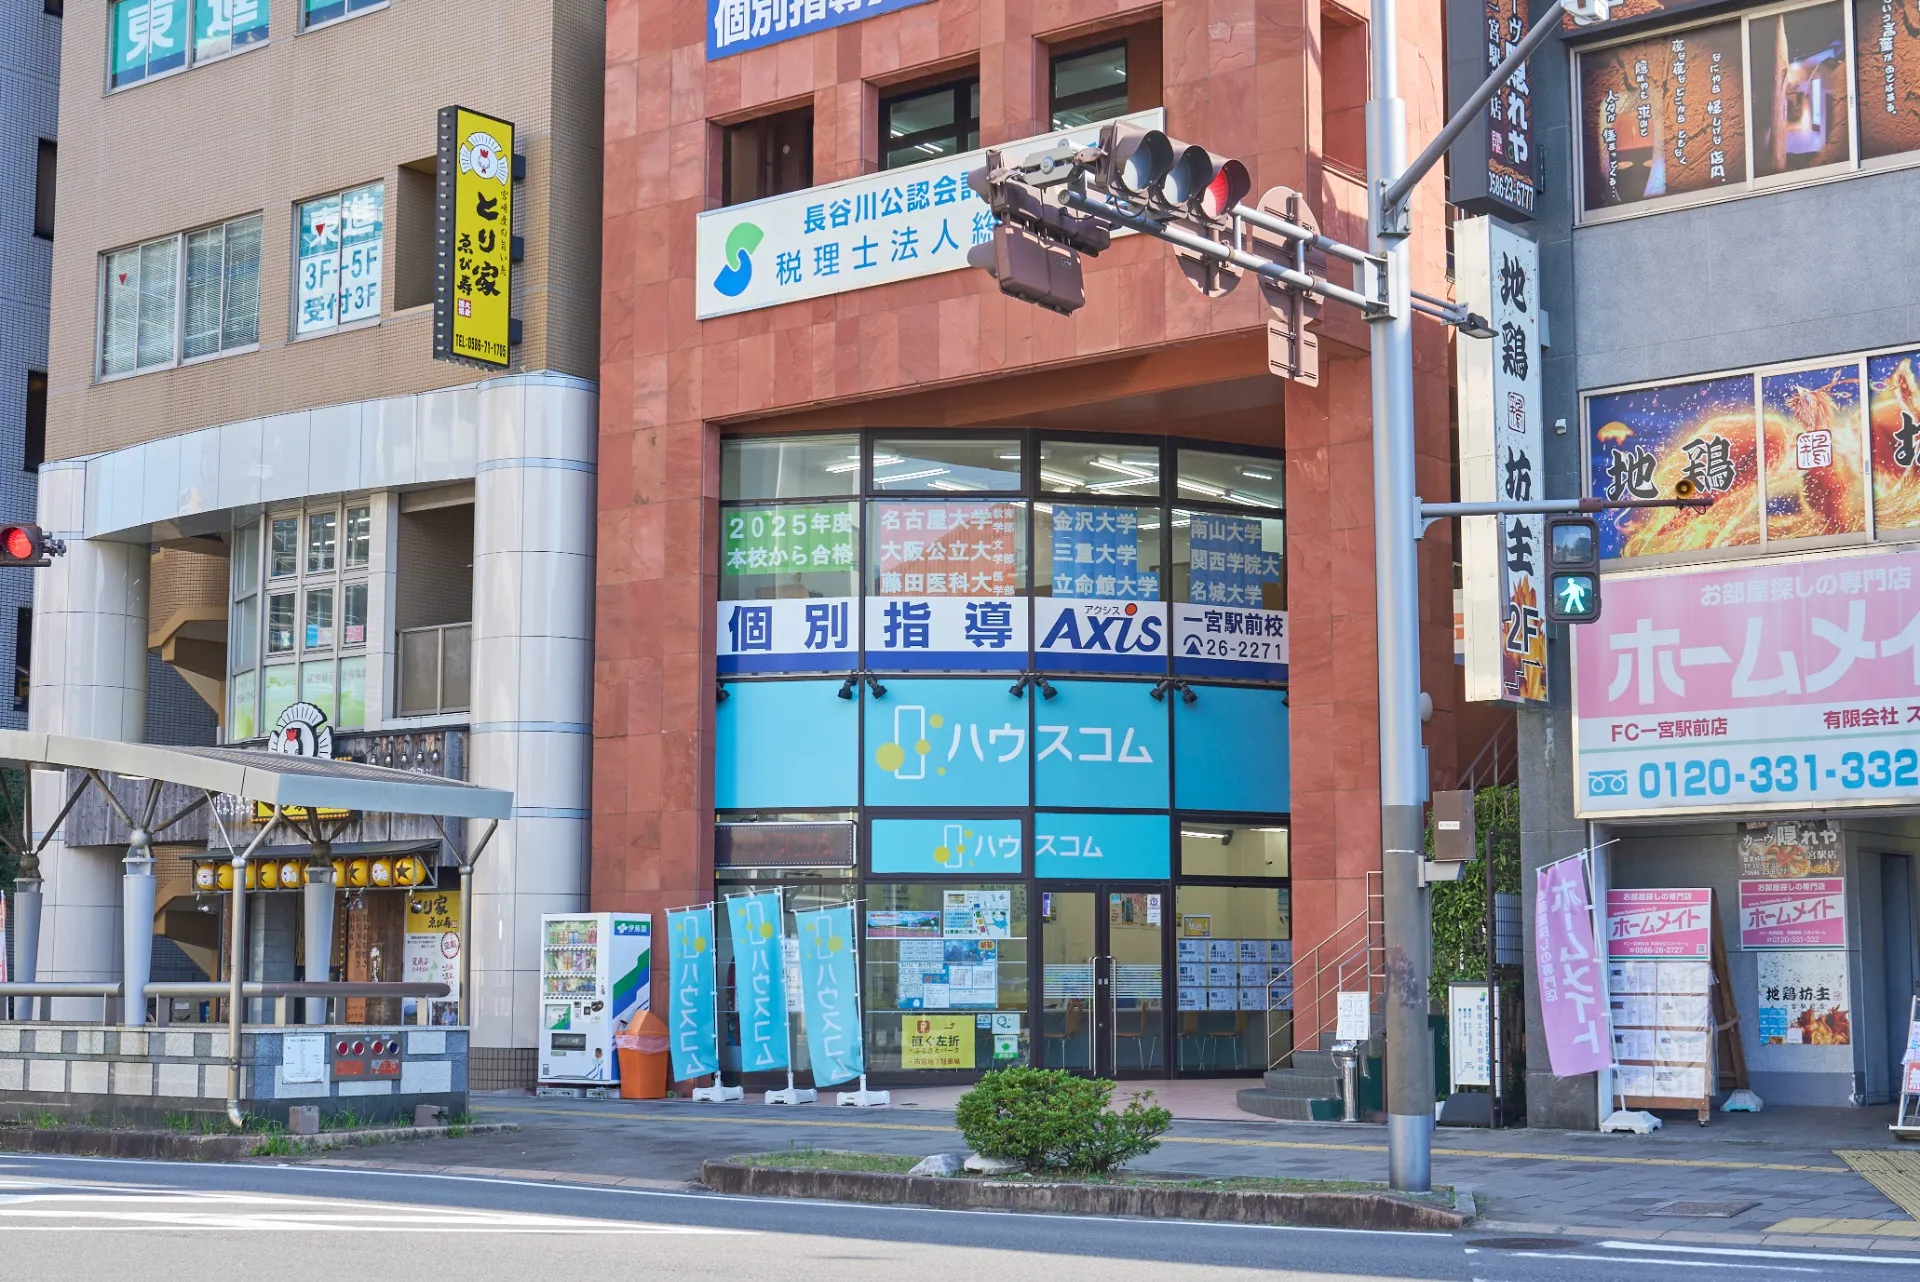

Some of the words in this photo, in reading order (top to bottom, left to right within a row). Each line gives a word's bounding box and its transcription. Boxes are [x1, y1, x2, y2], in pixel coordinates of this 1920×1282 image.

[715, 0, 897, 48] 個別指
[1879, 0, 1896, 61] いう言葉が
[729, 511, 853, 539] 2025年度
[881, 508, 993, 531] 名古屋大学
[1053, 511, 1137, 535] 金沢大学
[1190, 518, 1262, 545] 南山大学
[726, 543, 853, 569] 本校から合格
[881, 540, 992, 562] 大阪公立大
[1053, 542, 1137, 566] 三重大学
[1190, 548, 1280, 576] 関西学院大
[880, 571, 992, 594] 藤田医科大
[1053, 573, 1159, 598] 立命館大学
[1190, 580, 1262, 606] 名城大学
[1700, 566, 1912, 606] お部屋探しの専門店
[1084, 604, 1120, 615] アクシス
[1183, 610, 1284, 638] 一宮駅前校
[1506, 603, 1540, 656] 2F
[1206, 638, 1282, 660] 26-2271
[1823, 706, 1899, 730] 有限会社
[948, 722, 1154, 763] ハウスコム
[1638, 748, 1919, 799] 0120-331-332
[974, 834, 1104, 858] ハウスコム
[1612, 908, 1701, 938] ホームメイト
[1748, 898, 1836, 928] ホームメイト
[1765, 985, 1831, 1001] 地鶏坊主
[911, 1034, 960, 1047] 直ぐ左折
